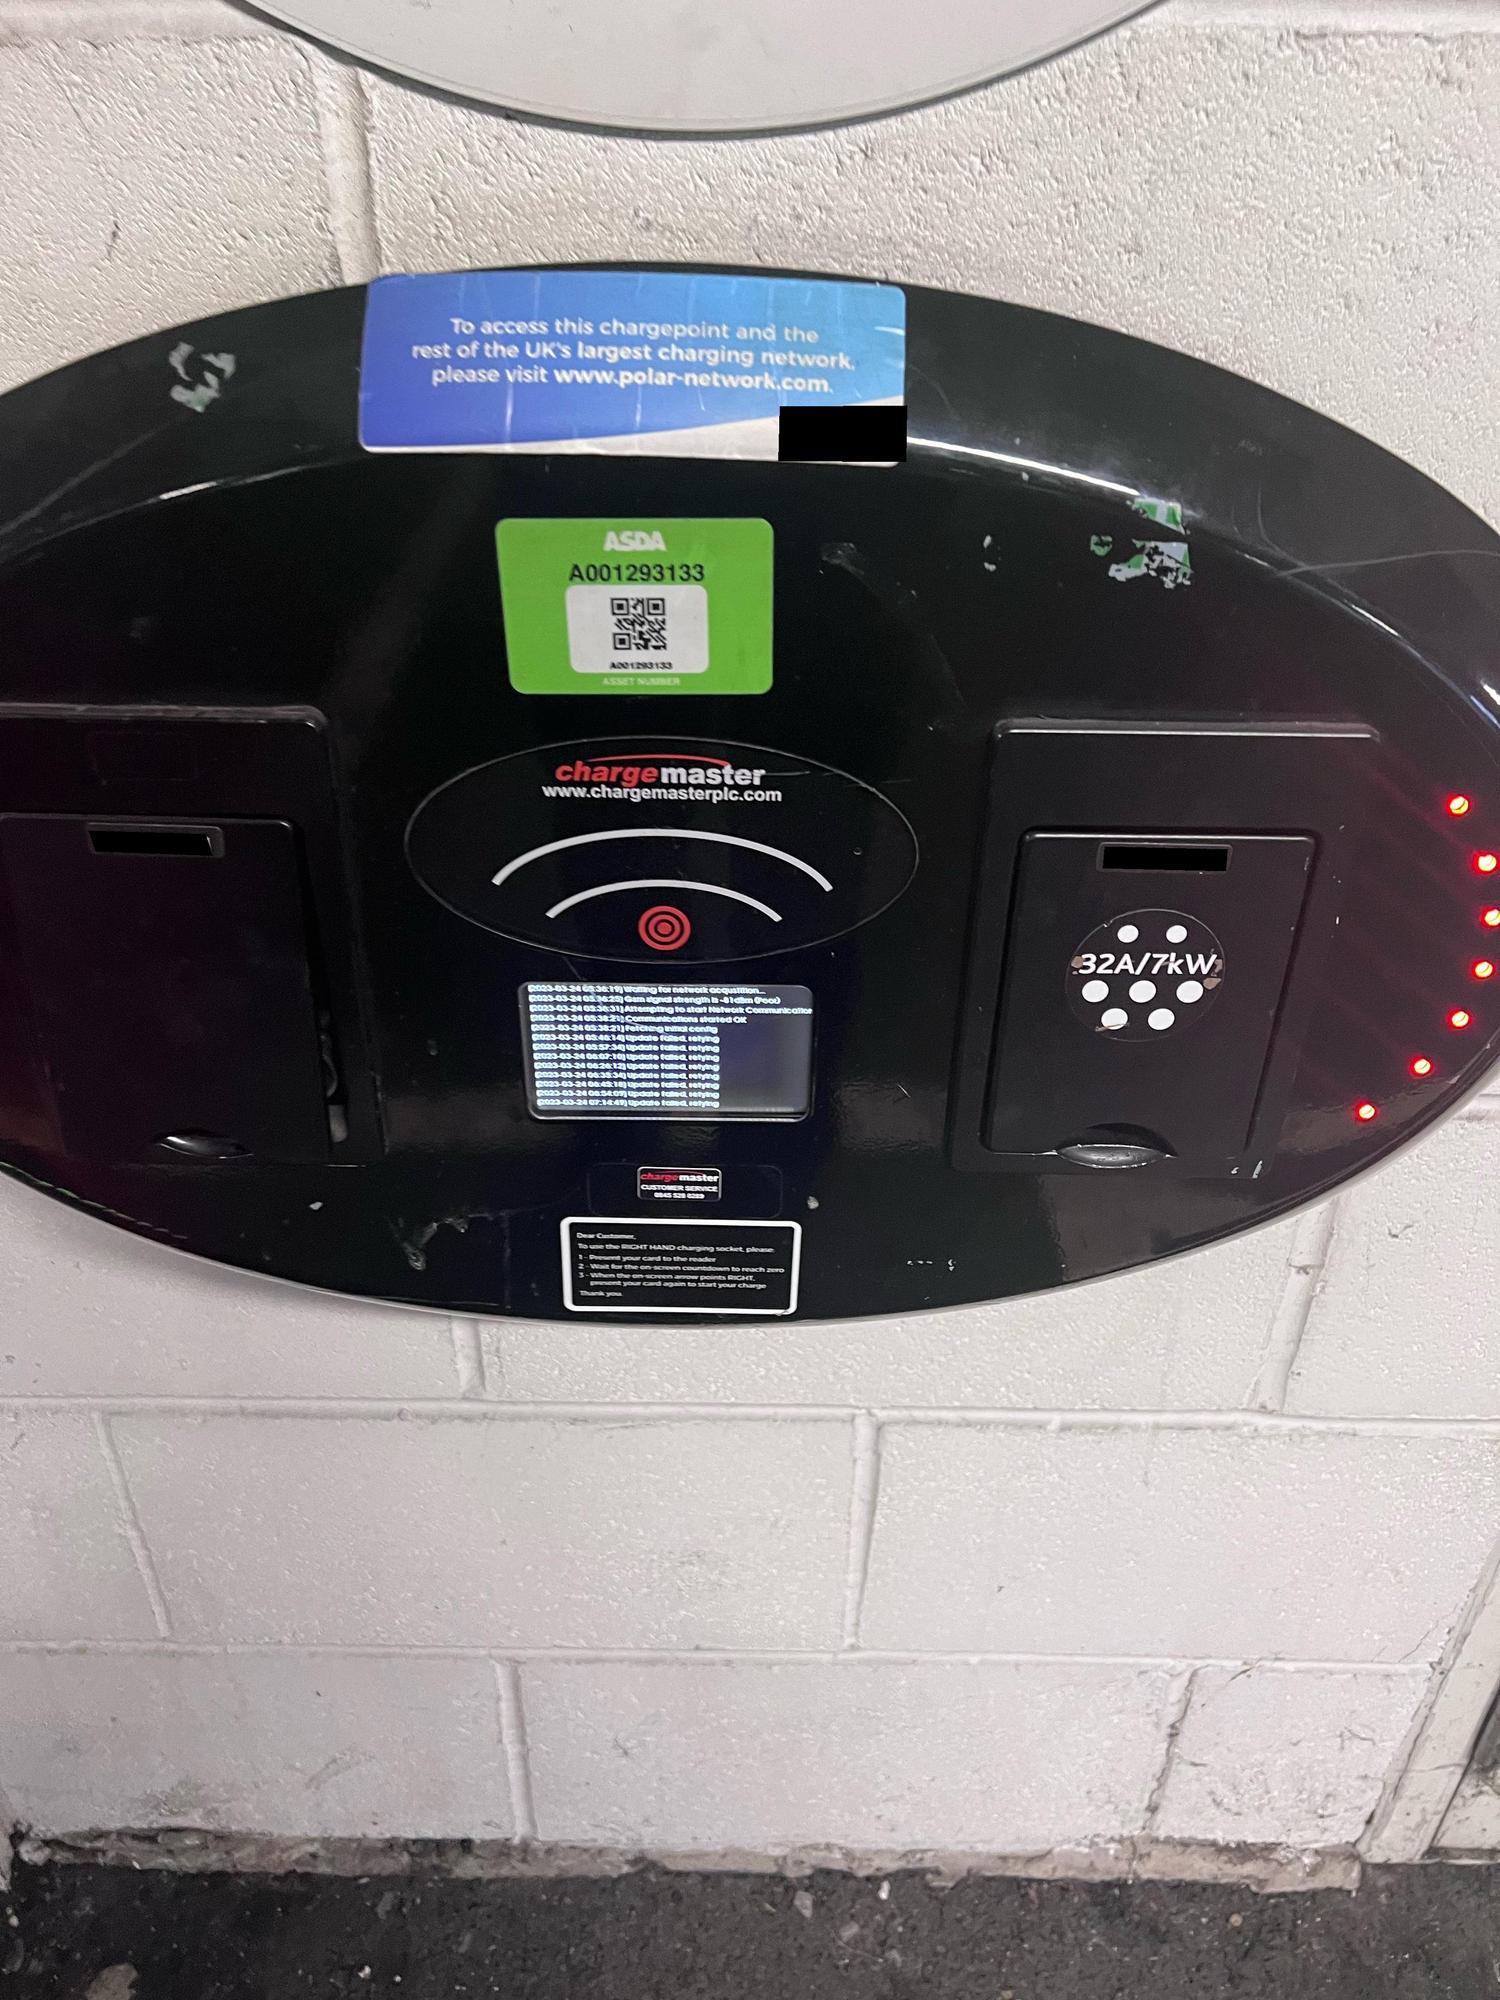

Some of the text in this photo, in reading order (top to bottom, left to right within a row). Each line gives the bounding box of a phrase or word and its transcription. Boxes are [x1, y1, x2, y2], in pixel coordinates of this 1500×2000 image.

[450, 317, 819, 344] To access this chargepoint and the
[411, 342, 450, 359] rest
[456, 340, 480, 359] of
[484, 341, 519, 359] the
[525, 341, 572, 360] UK's
[577, 341, 652, 364] largest
[657, 344, 754, 368] charging
[432, 365, 500, 387] please
[505, 365, 548, 384] visit
[603, 530, 667, 551] ASDA
[569, 563, 705, 582] A001293133
[609, 661, 673, 670] A001293133
[603, 677, 681, 686] ASSET NUMBER
[541, 784, 782, 803] www.chargemasterplc.com
[1078, 952, 1218, 975] 32A/7kW
[624, 986, 658, 995] Waiting
[672, 986, 708, 994] network
[646, 996, 672, 1005] signal
[673, 996, 710, 1006] strength
[624, 1005, 674, 1014] Attempting
[687, 1006, 707, 1014] start
[708, 1006, 744, 1014] Network
[700, 1016, 733, 1024] started
[733, 1016, 747, 1024] OK
[688, 1026, 718, 1034] config
[625, 1034, 659, 1042] Update
[625, 1044, 659, 1052] Update
[626, 1054, 659, 1062] Update
[626, 1063, 659, 1071] Update
[626, 1072, 659, 1080] Update
[627, 1082, 659, 1090] Update
[627, 1091, 660, 1099] Update
[628, 1100, 660, 1108] Update
[737, 1282, 767, 1290] charge
